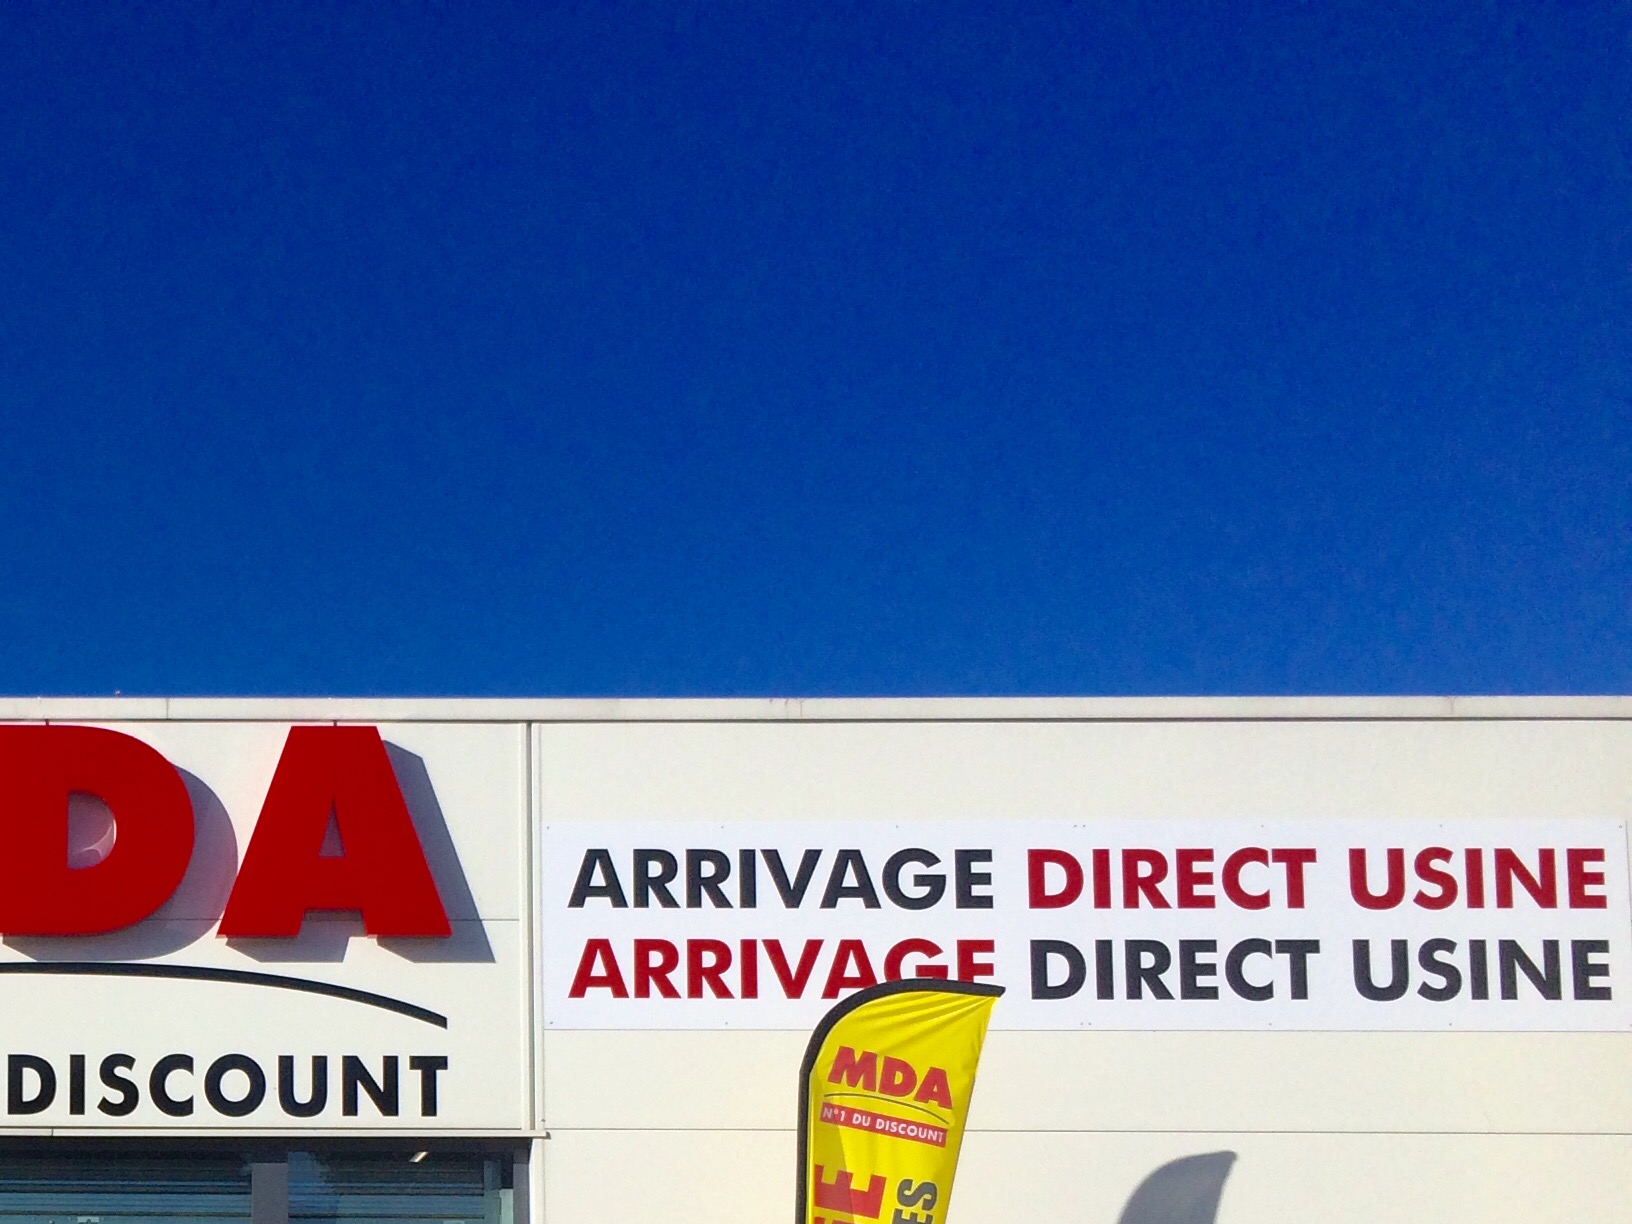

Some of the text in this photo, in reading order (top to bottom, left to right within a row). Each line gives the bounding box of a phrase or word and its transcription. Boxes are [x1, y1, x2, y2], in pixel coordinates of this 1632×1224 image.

[567, 846, 1609, 912] ARRIVAGE DIRECT USINE
[567, 937, 1613, 1002] ARRIVAGE DIRECT USINE
[7, 1053, 449, 1118] DISCOUNT
[827, 1045, 953, 1110] MDA
[822, 1106, 945, 1143] N°1 DU DISCOUNT
